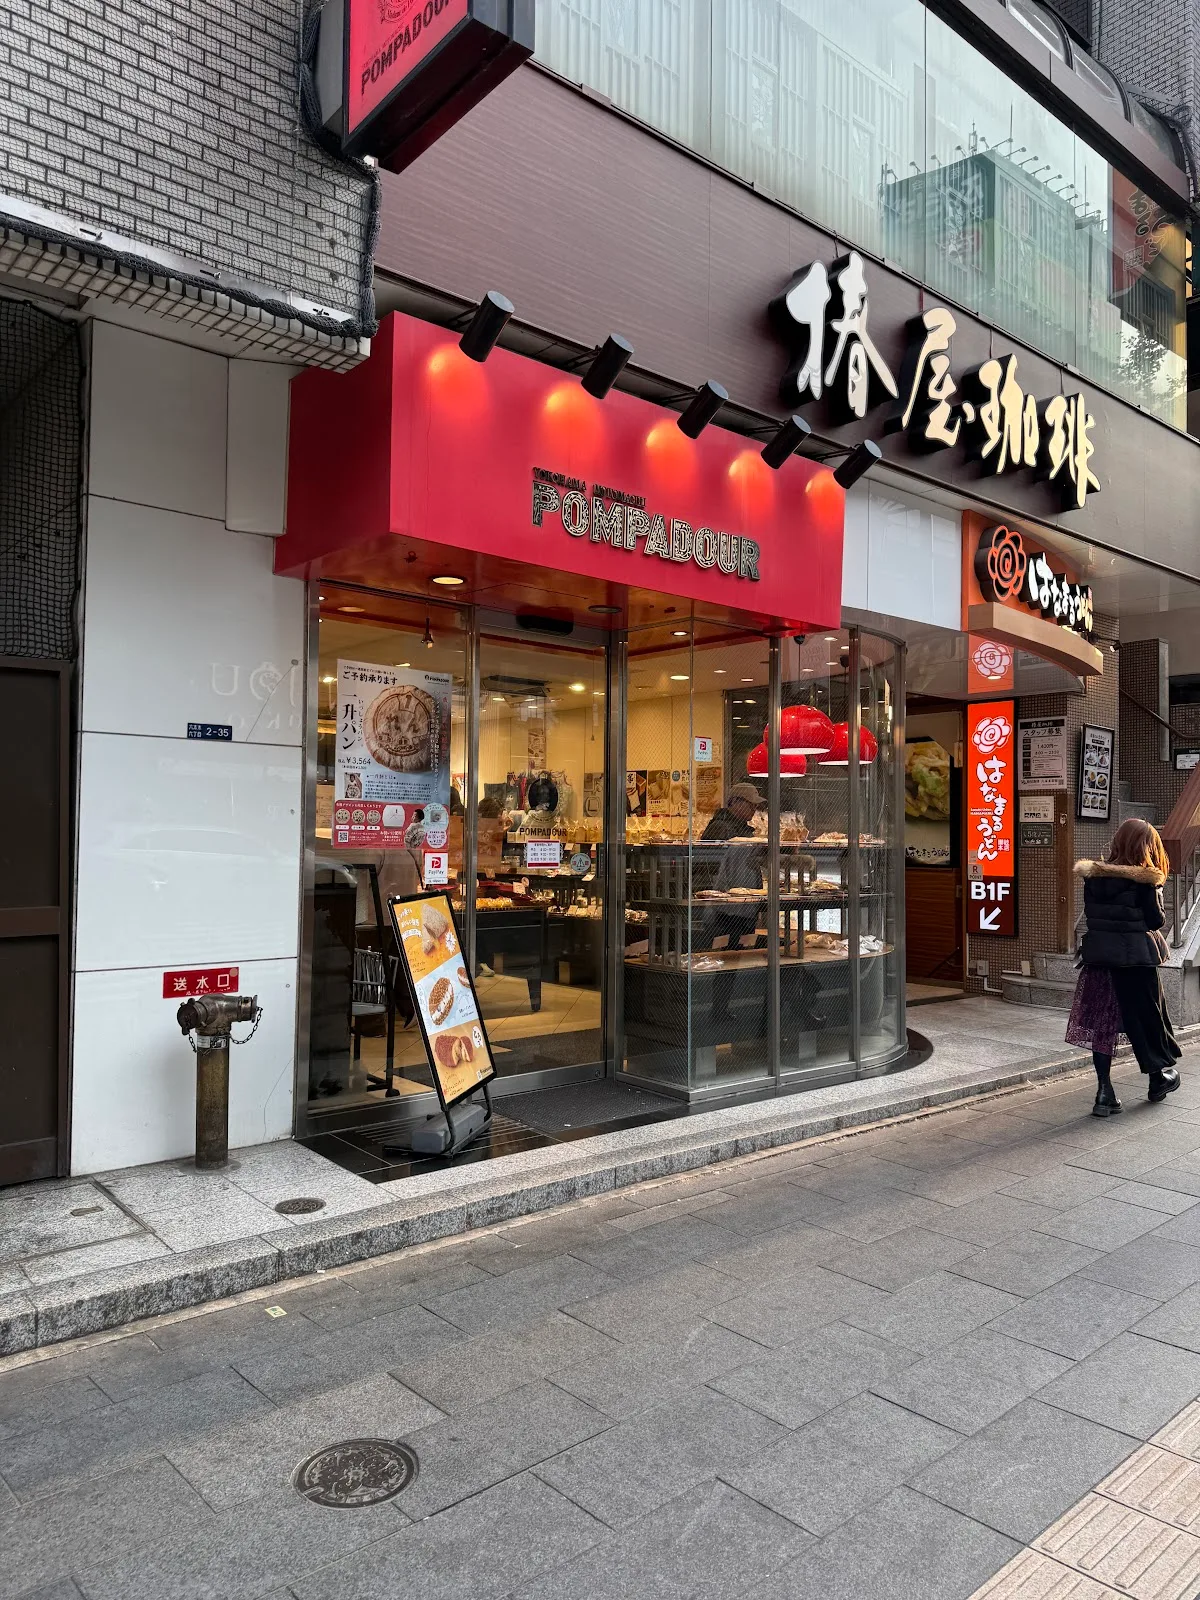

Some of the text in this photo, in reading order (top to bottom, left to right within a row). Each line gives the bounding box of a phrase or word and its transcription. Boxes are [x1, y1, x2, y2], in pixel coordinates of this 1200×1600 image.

[361, 0, 453, 96] POMPADOU
[786, 250, 1102, 509] 椿屋珈琲
[532, 480, 761, 582] POMPADOUR
[342, 671, 398, 686] ご予約承ります
[206, 727, 229, 738] 2-35
[341, 693, 358, 750] 一升パン
[976, 755, 1007, 861] はなまるうどん
[519, 828, 568, 837] POMPADOUR
[970, 881, 1011, 901] B1F
[173, 974, 230, 992] 送水口
